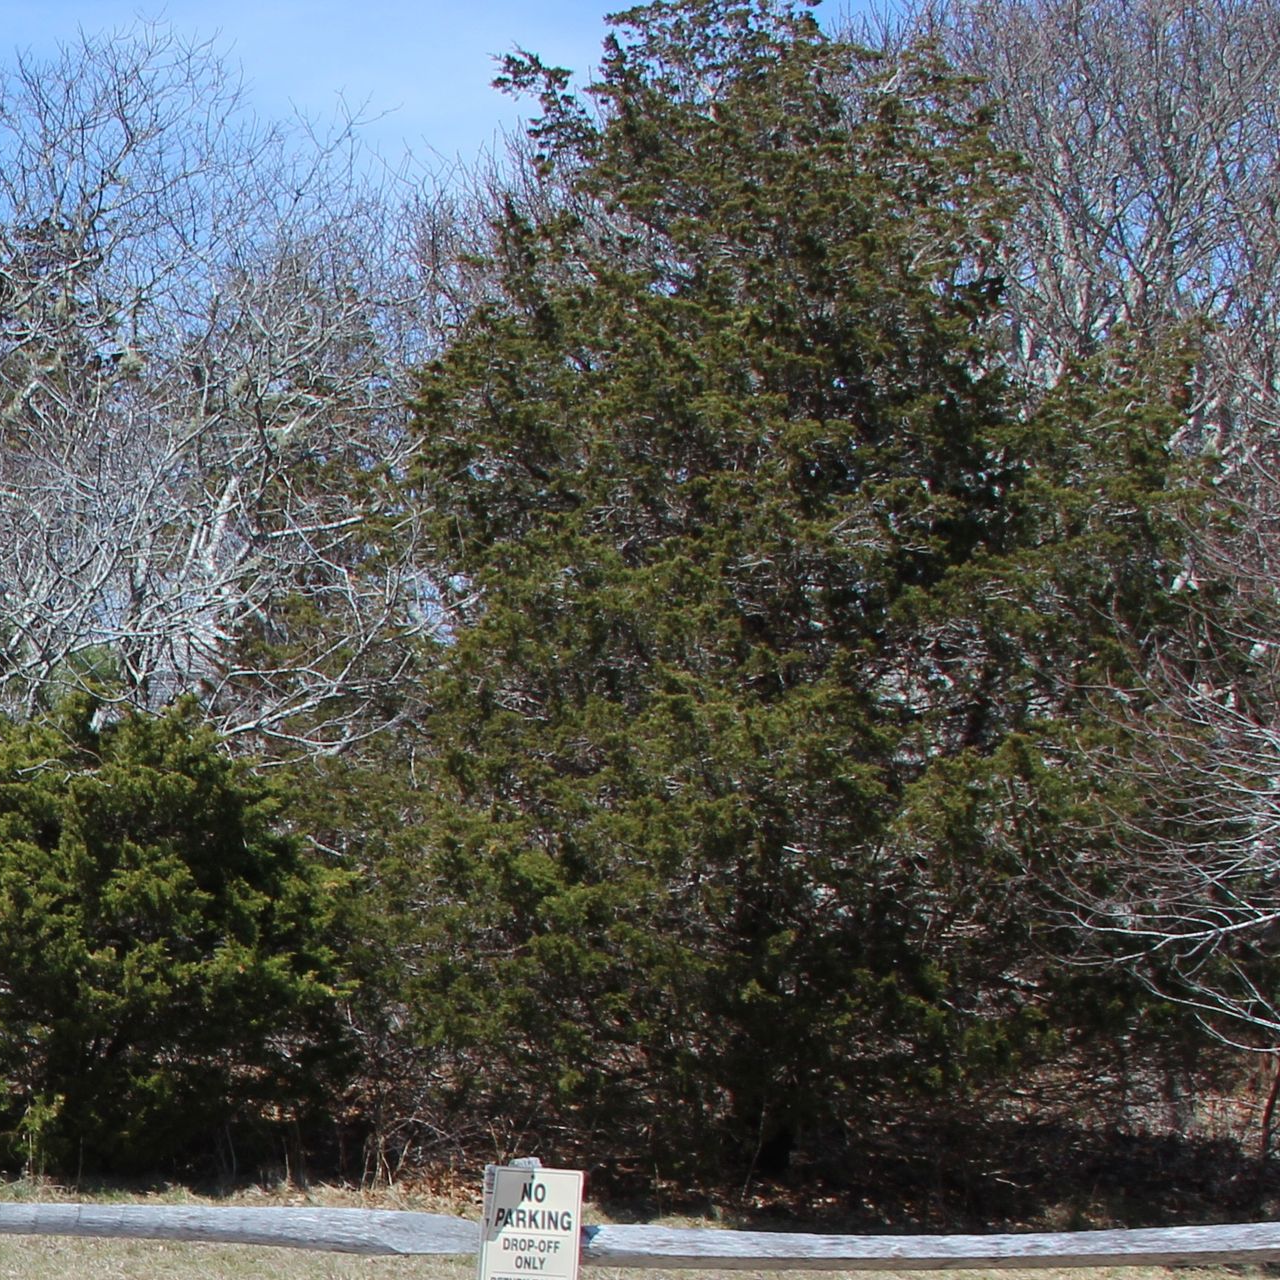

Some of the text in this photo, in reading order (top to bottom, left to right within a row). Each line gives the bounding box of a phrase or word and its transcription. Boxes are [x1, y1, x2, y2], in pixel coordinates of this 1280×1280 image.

[521, 1183, 546, 1203] NO
[494, 1208, 572, 1231] PARKING
[502, 1238, 560, 1253] DROP-OFF
[515, 1256, 546, 1270] ONLY
